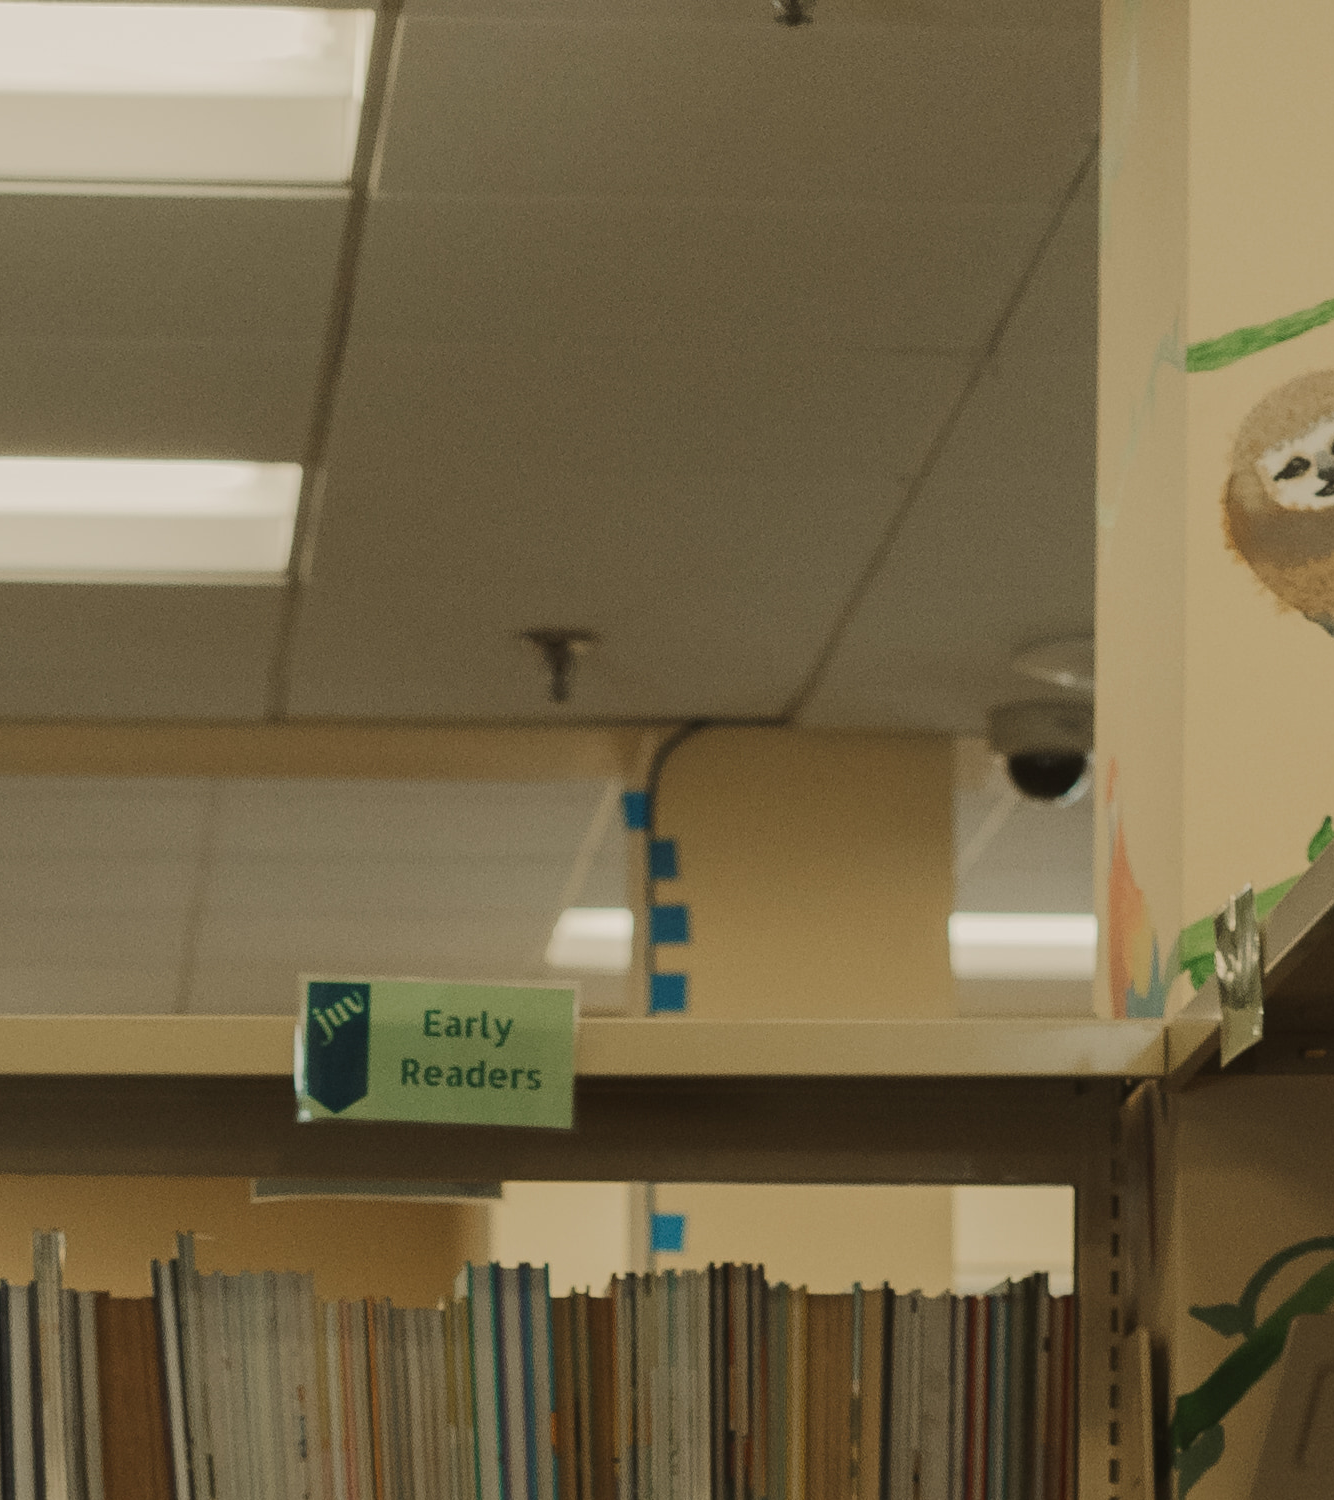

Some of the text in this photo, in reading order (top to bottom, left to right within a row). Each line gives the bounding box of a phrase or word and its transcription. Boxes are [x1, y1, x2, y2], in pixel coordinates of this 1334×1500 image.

[313, 991, 365, 1046] juv
[424, 1010, 514, 1047] Early
[401, 1059, 542, 1091] Readers
